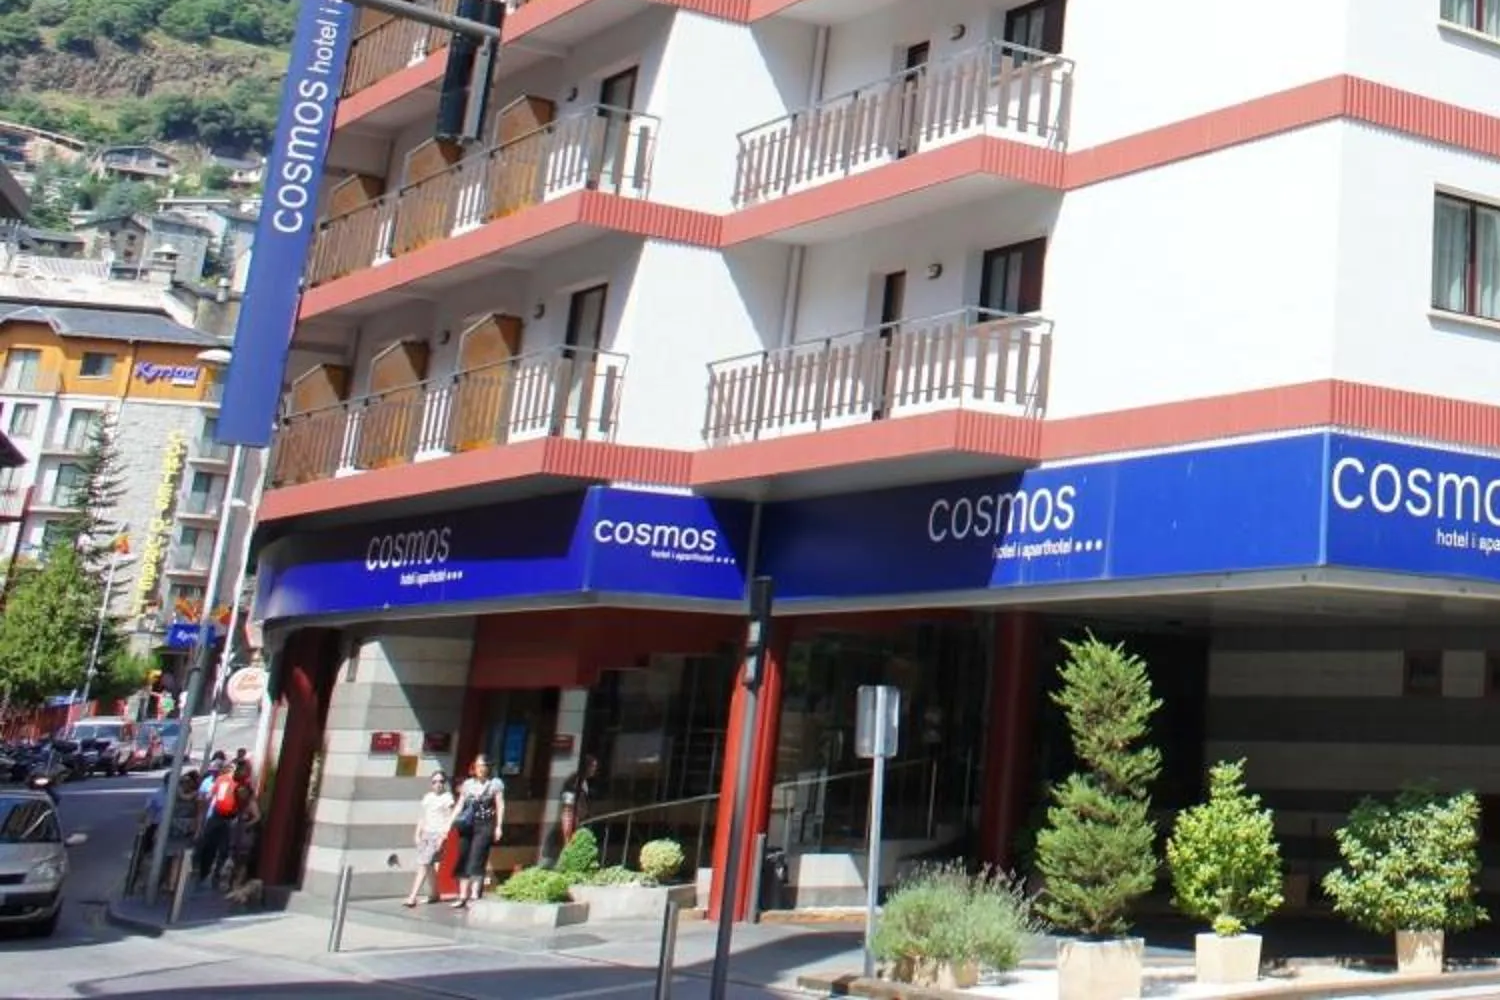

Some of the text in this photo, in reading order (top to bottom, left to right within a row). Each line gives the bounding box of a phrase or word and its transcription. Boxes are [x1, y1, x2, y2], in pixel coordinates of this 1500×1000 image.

[272, 79, 328, 233] cosmos
[307, 17, 340, 74] hotel
[928, 484, 1076, 542] cosmos
[366, 527, 452, 571] cosmos
[595, 519, 717, 551] cosmos
[992, 540, 1017, 559] hotel
[1022, 535, 1072, 561] aparthotel
[1436, 528, 1468, 547] hotel
